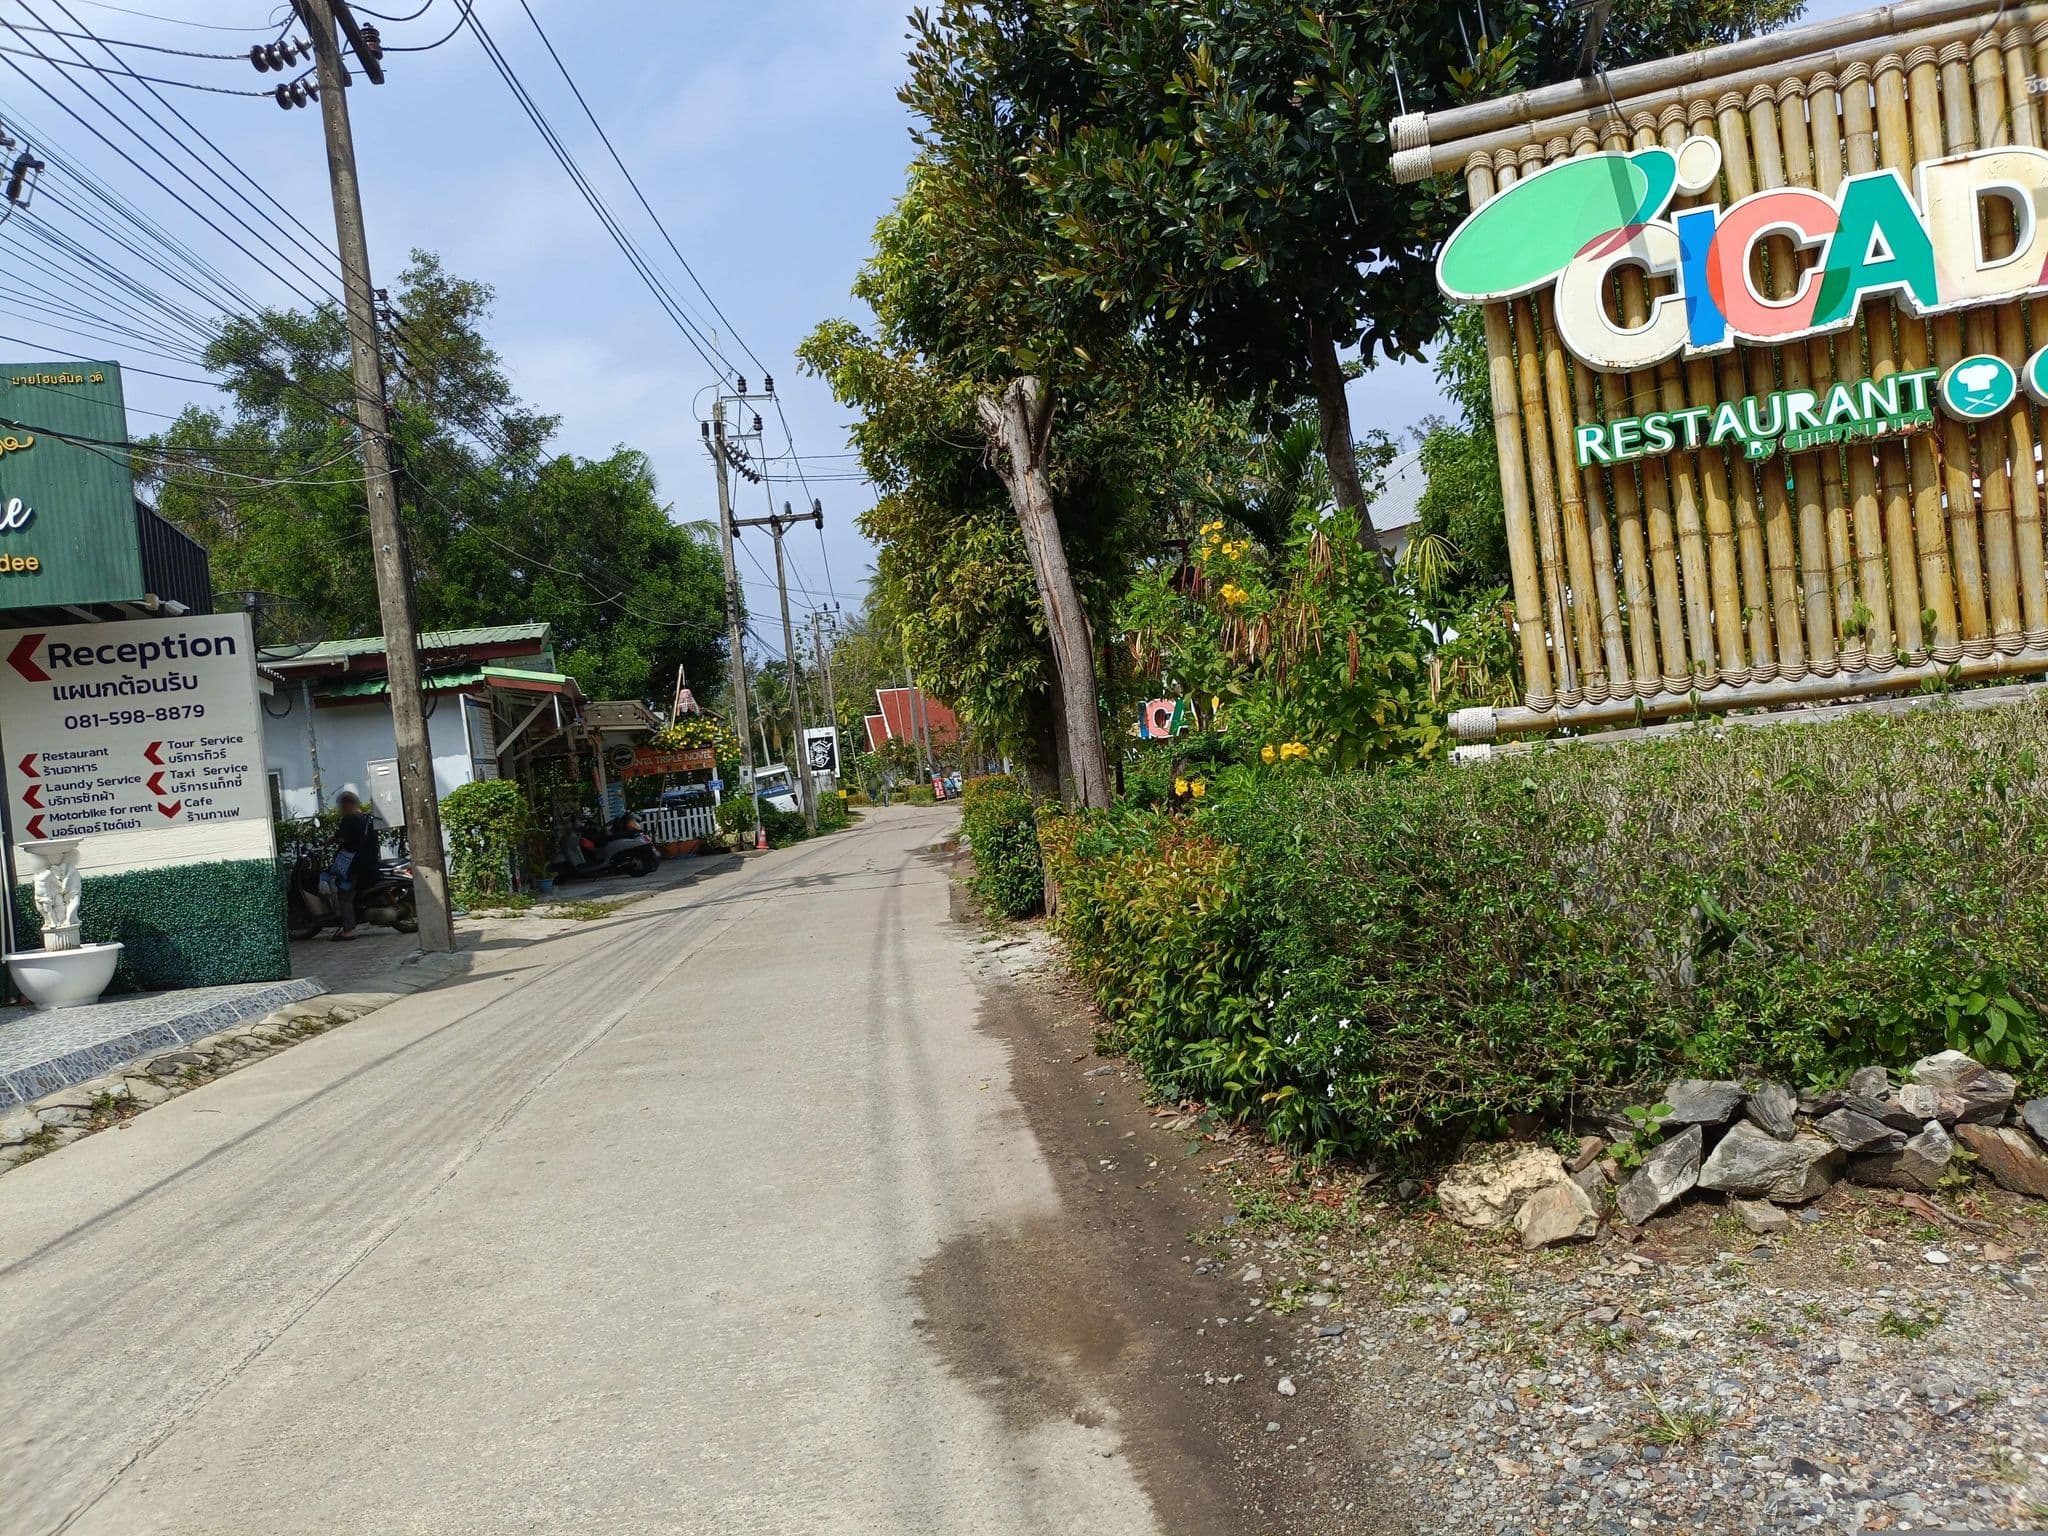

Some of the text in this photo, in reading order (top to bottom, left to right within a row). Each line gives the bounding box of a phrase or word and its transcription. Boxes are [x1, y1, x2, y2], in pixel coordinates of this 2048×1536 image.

[1555, 145, 2048, 373] CICAD
[1575, 367, 1940, 468] RESTAURANT
[47, 633, 237, 670] Reception
[52, 671, 198, 701] แผนกต้อนรับ
[64, 704, 205, 730] 081-598-8879
[167, 735, 244, 750] Tour Service
[42, 747, 109, 762] Restaurant
[655, 753, 683, 764] TRIPLE
[169, 764, 248, 779] Taxi Service
[46, 775, 141, 792] Laundy Service
[184, 797, 213, 808] Cafe
[49, 803, 153, 822] Motorbike for rent
[187, 807, 240, 822] ร้านกาแฟ
